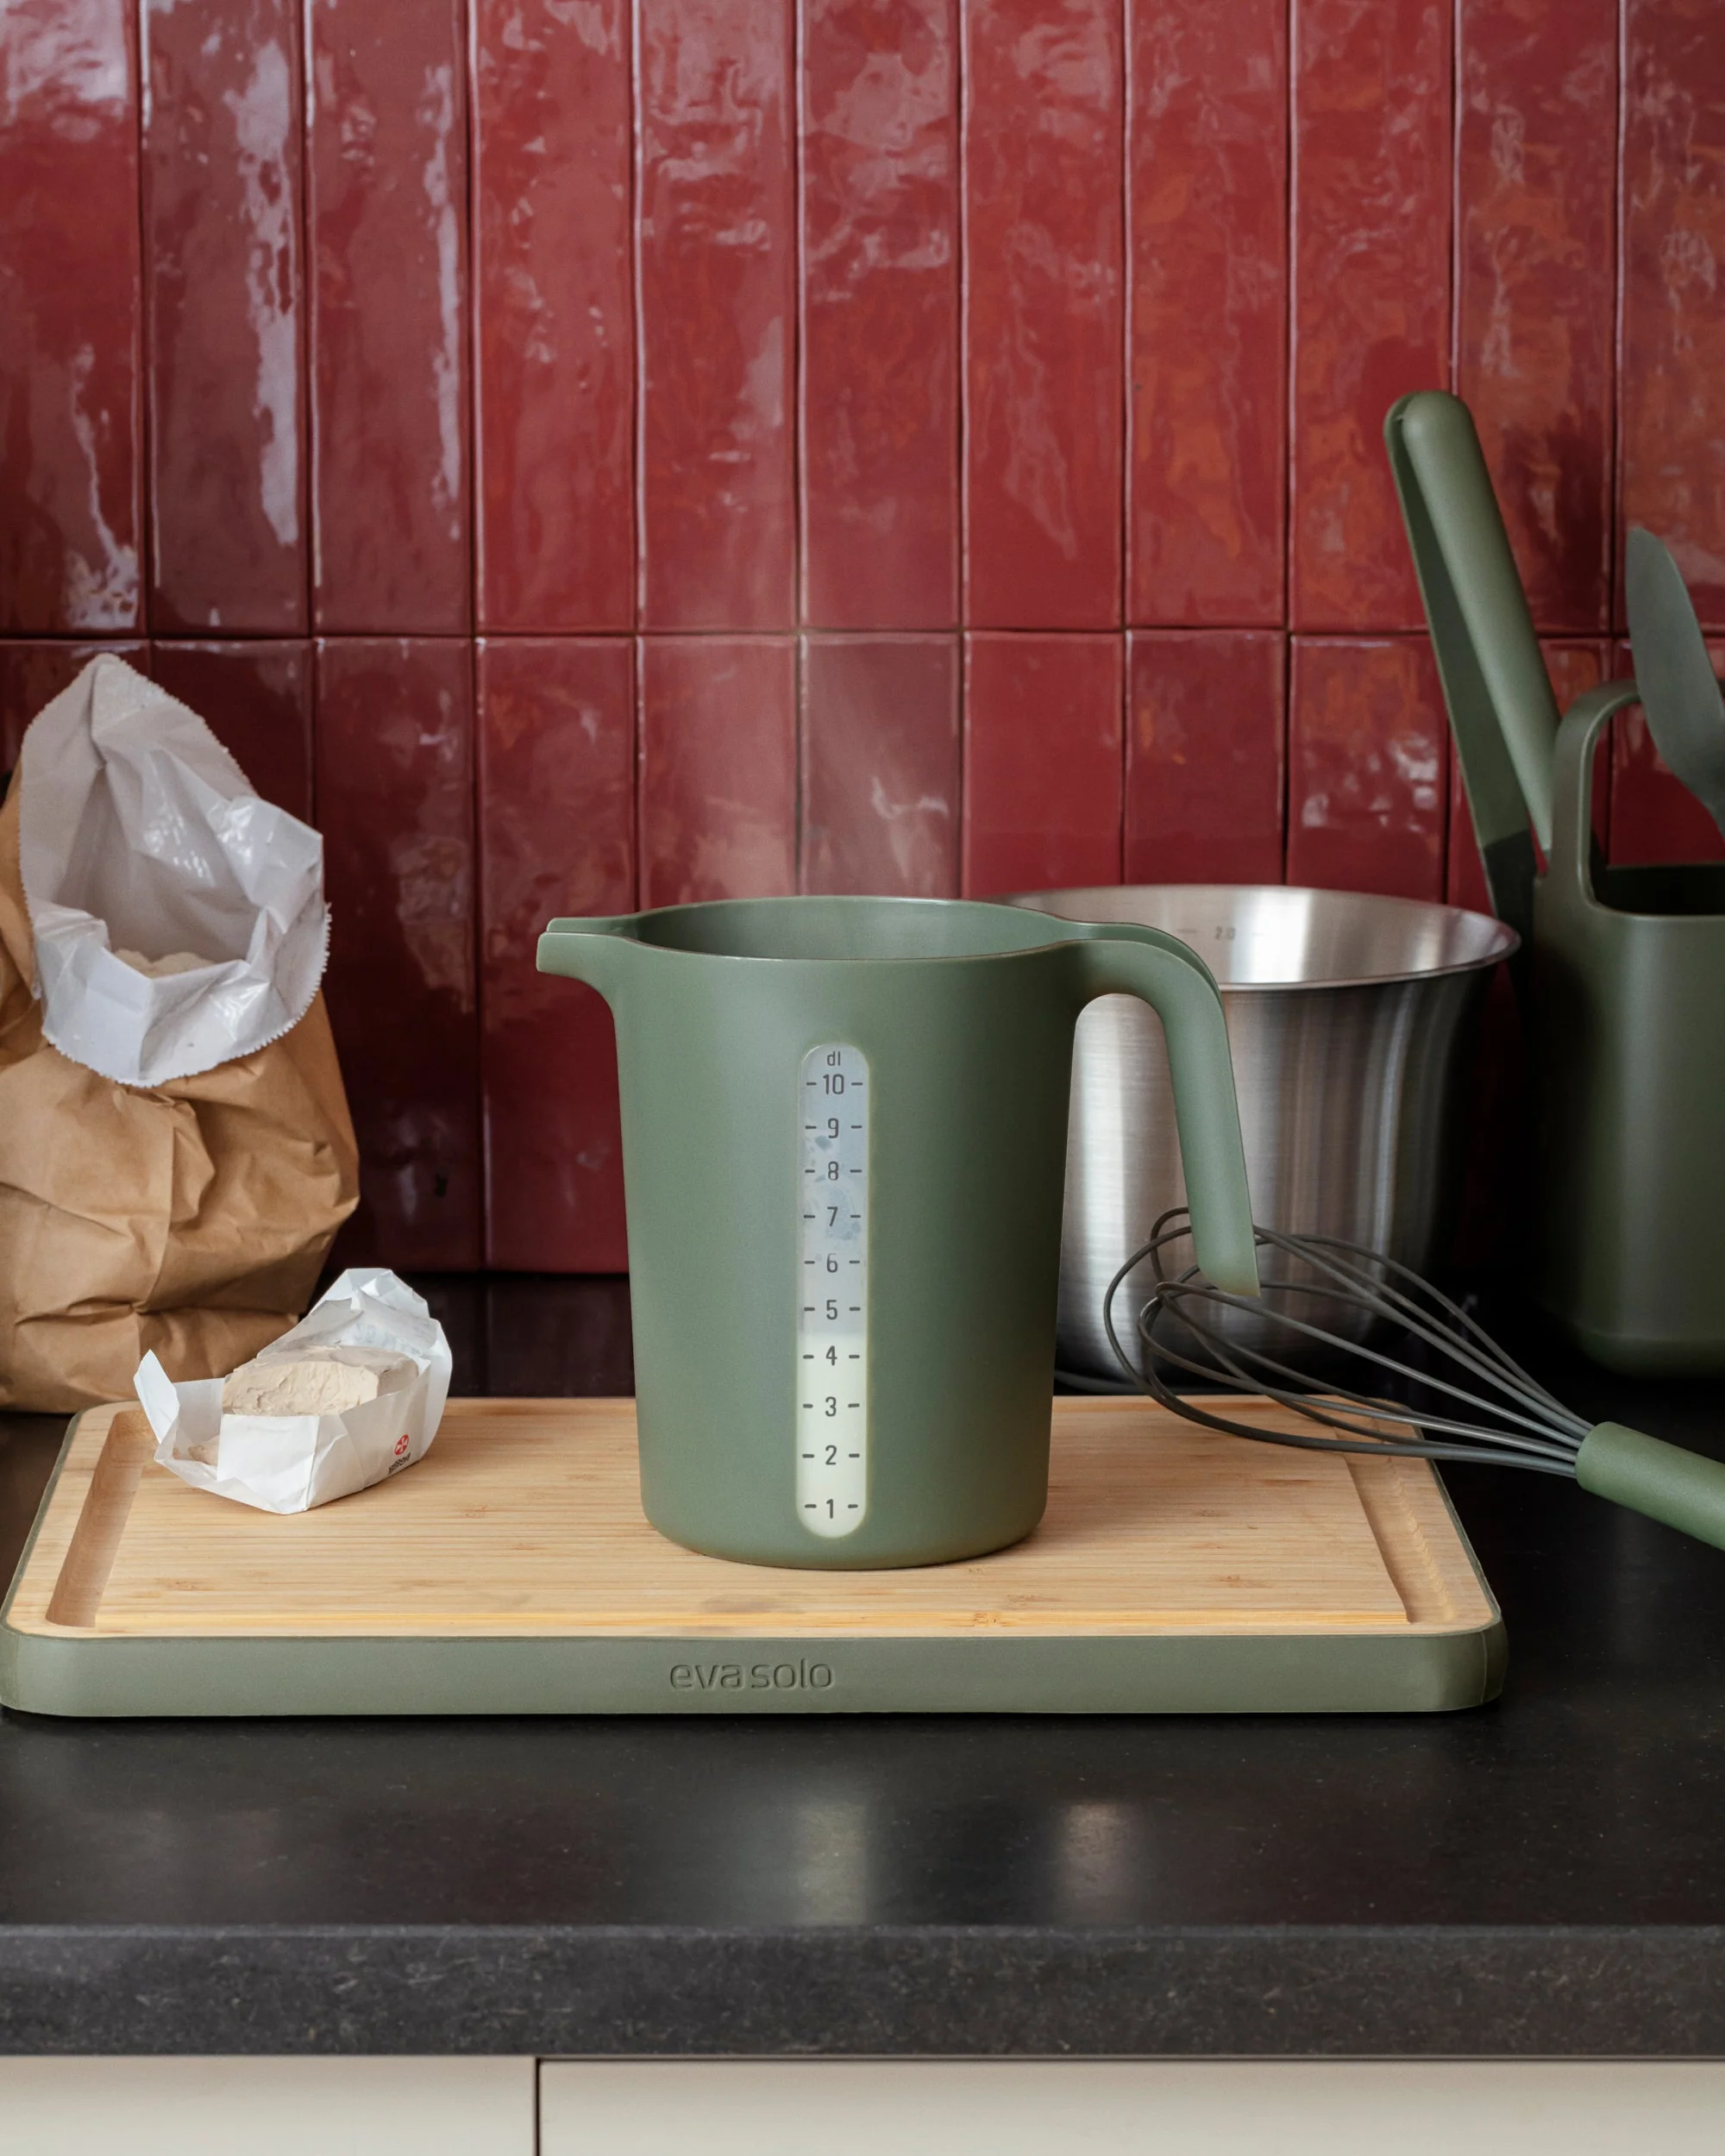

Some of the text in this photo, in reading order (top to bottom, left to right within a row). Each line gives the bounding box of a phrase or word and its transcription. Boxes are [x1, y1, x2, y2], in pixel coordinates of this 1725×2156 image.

[826, 1050, 841, 1067] dl
[823, 1073, 844, 1095] 10
[827, 1118, 839, 1139] 9
[827, 1161, 839, 1181] 8
[826, 1206, 839, 1227] 7
[826, 1253, 838, 1274] 6
[825, 1299, 838, 1320] 5
[825, 1345, 837, 1366] 4
[825, 1396, 837, 1417] 3
[825, 1445, 837, 1465] 2
[825, 1498, 834, 1520] 1
